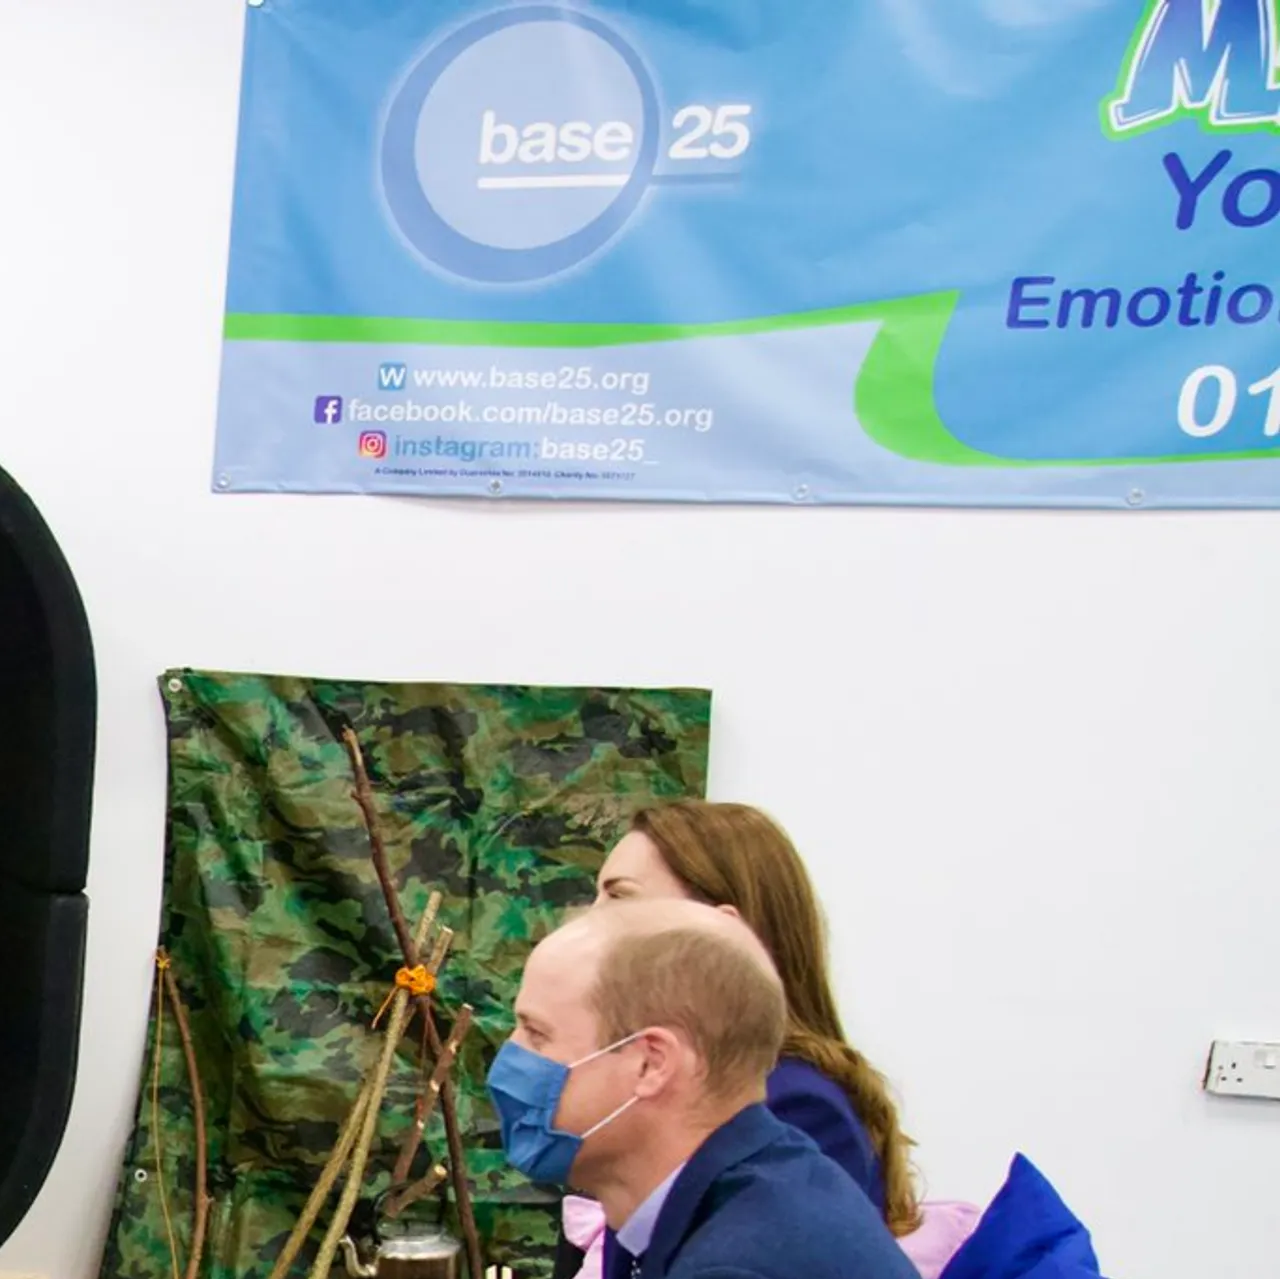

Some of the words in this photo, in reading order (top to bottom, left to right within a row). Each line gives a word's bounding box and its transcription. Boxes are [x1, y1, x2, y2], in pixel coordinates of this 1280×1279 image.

[478, 110, 634, 164] base
[668, 104, 752, 160] 25
[1006, 269, 1280, 330] Emotio
[413, 366, 650, 394] www.base25.org
[348, 399, 713, 431] facebook.com/base25.org
